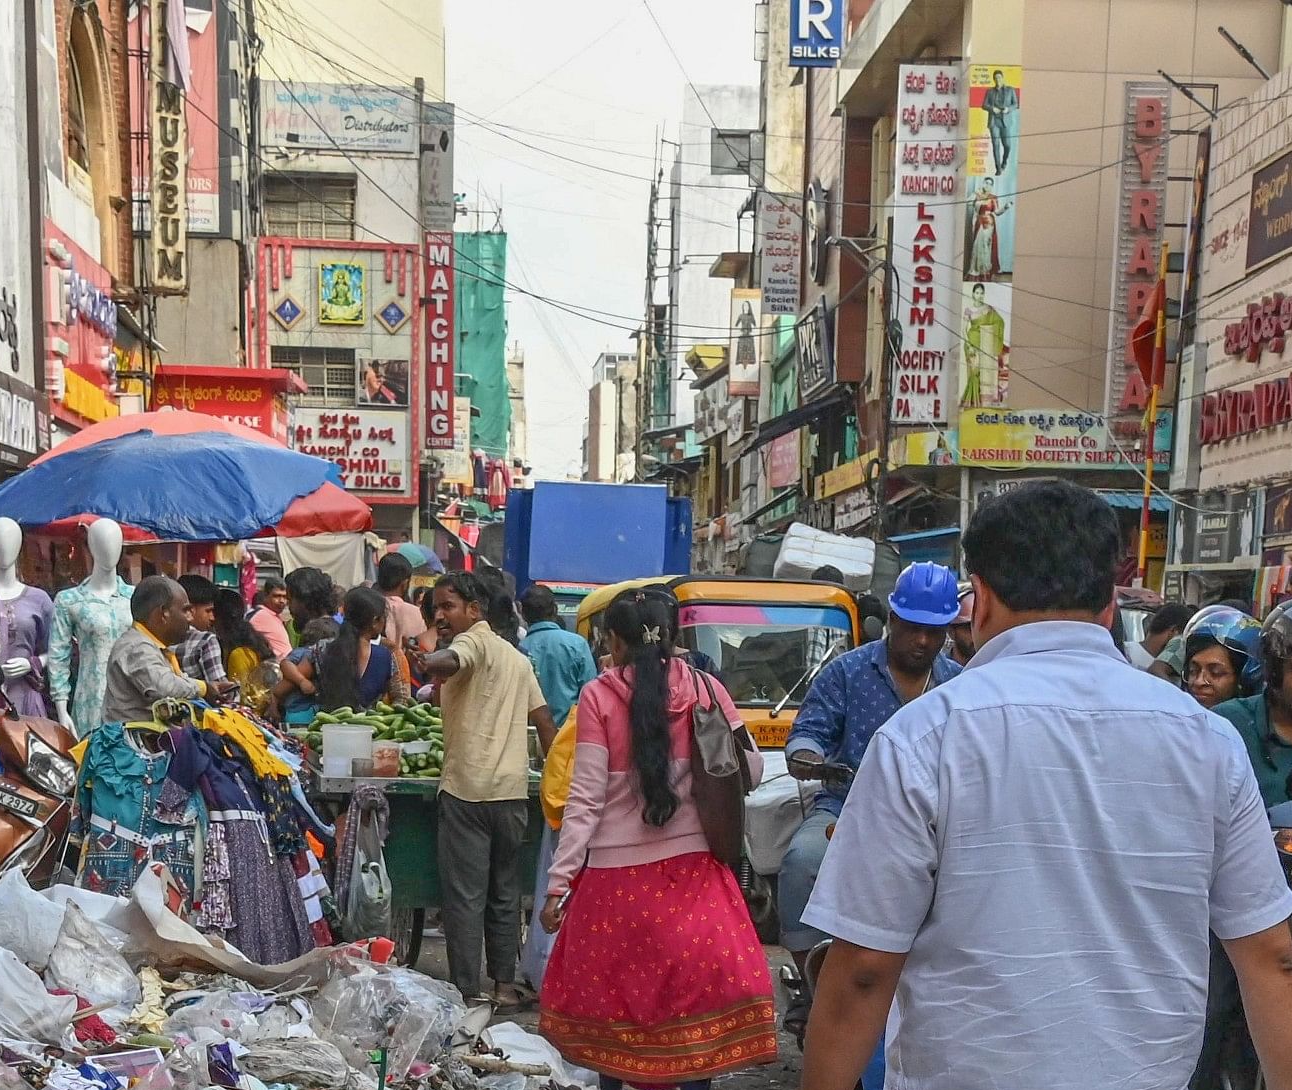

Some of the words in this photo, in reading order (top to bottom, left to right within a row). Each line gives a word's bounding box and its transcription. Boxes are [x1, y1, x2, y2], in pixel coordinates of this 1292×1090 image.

[791, 46, 840, 59] SILKS
[343, 115, 410, 134] Distributors
[155, 80, 184, 282] MUSEUM
[909, 201, 937, 347] LAKSHMI
[428, 244, 451, 436] MATCHING
[899, 374, 940, 396] SILK
[426, 436, 453, 447] CENTRE
[1080, 434, 1098, 449] Co
[299, 444, 350, 458] KANCHI
[362, 447, 380, 457] CO
[961, 447, 1022, 462] LAKSHMI
[1024, 450, 1083, 463] SOCIETY
[1084, 451, 1116, 464] SILK
[354, 475, 401, 489] SILKS
